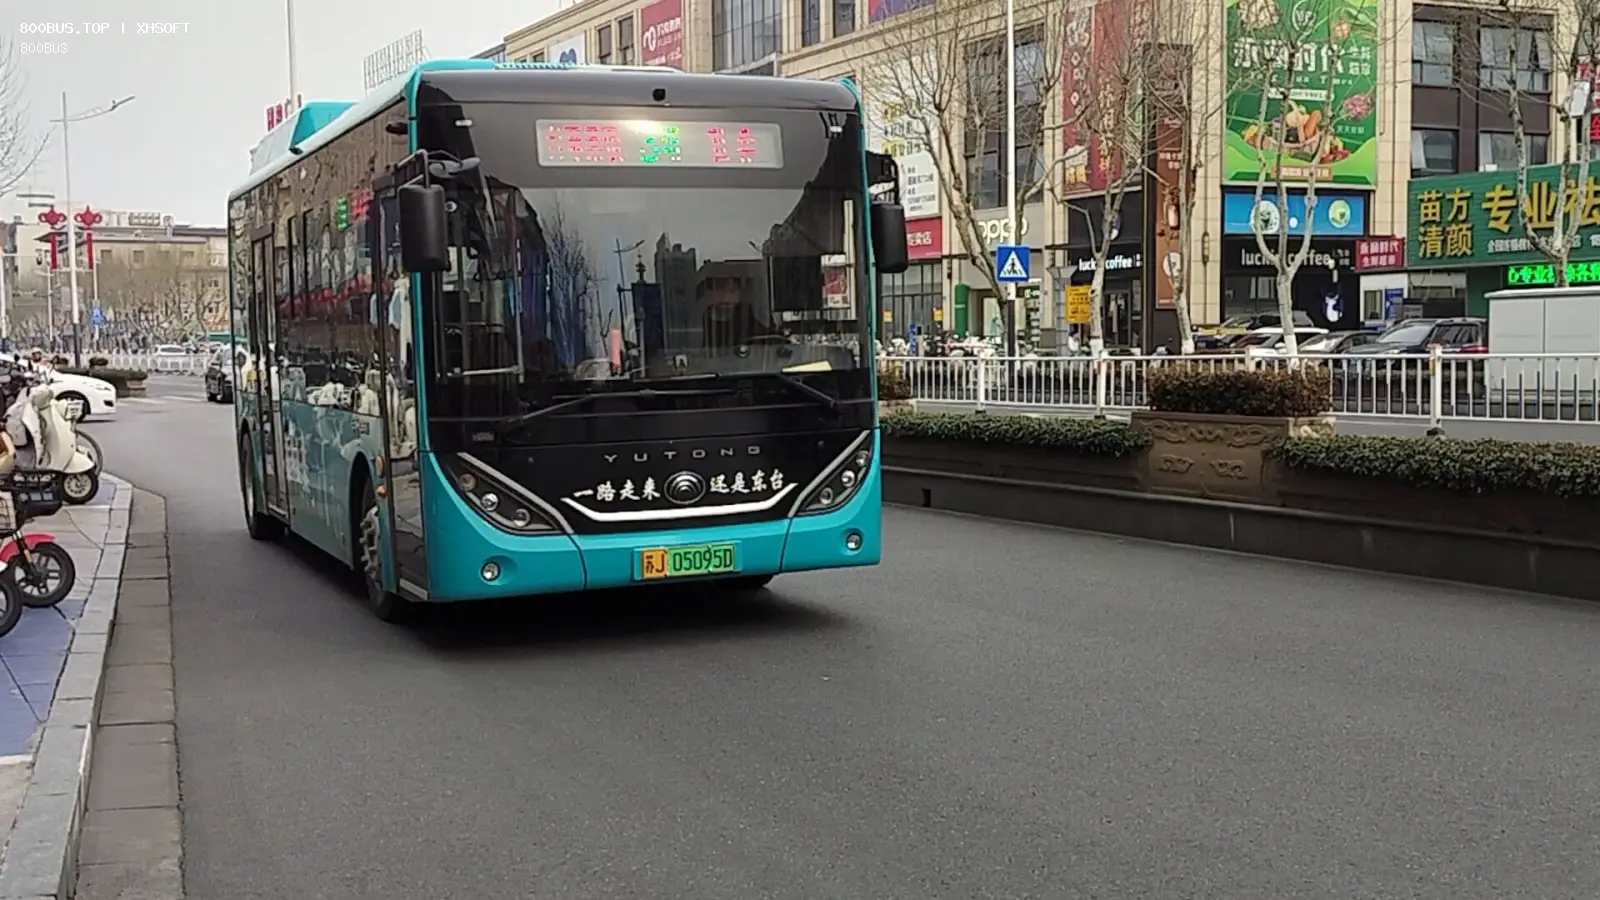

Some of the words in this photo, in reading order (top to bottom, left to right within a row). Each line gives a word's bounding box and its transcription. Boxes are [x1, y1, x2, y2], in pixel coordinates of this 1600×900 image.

[1418, 188, 1473, 223] 苗方
[1419, 223, 1473, 258] 清颜
[1105, 254, 1132, 269] coffee
[1287, 249, 1332, 266] cffee
[604, 445, 761, 464] YUTONG
[573, 477, 661, 502] 一路走来
[709, 469, 784, 494] 还是东台
